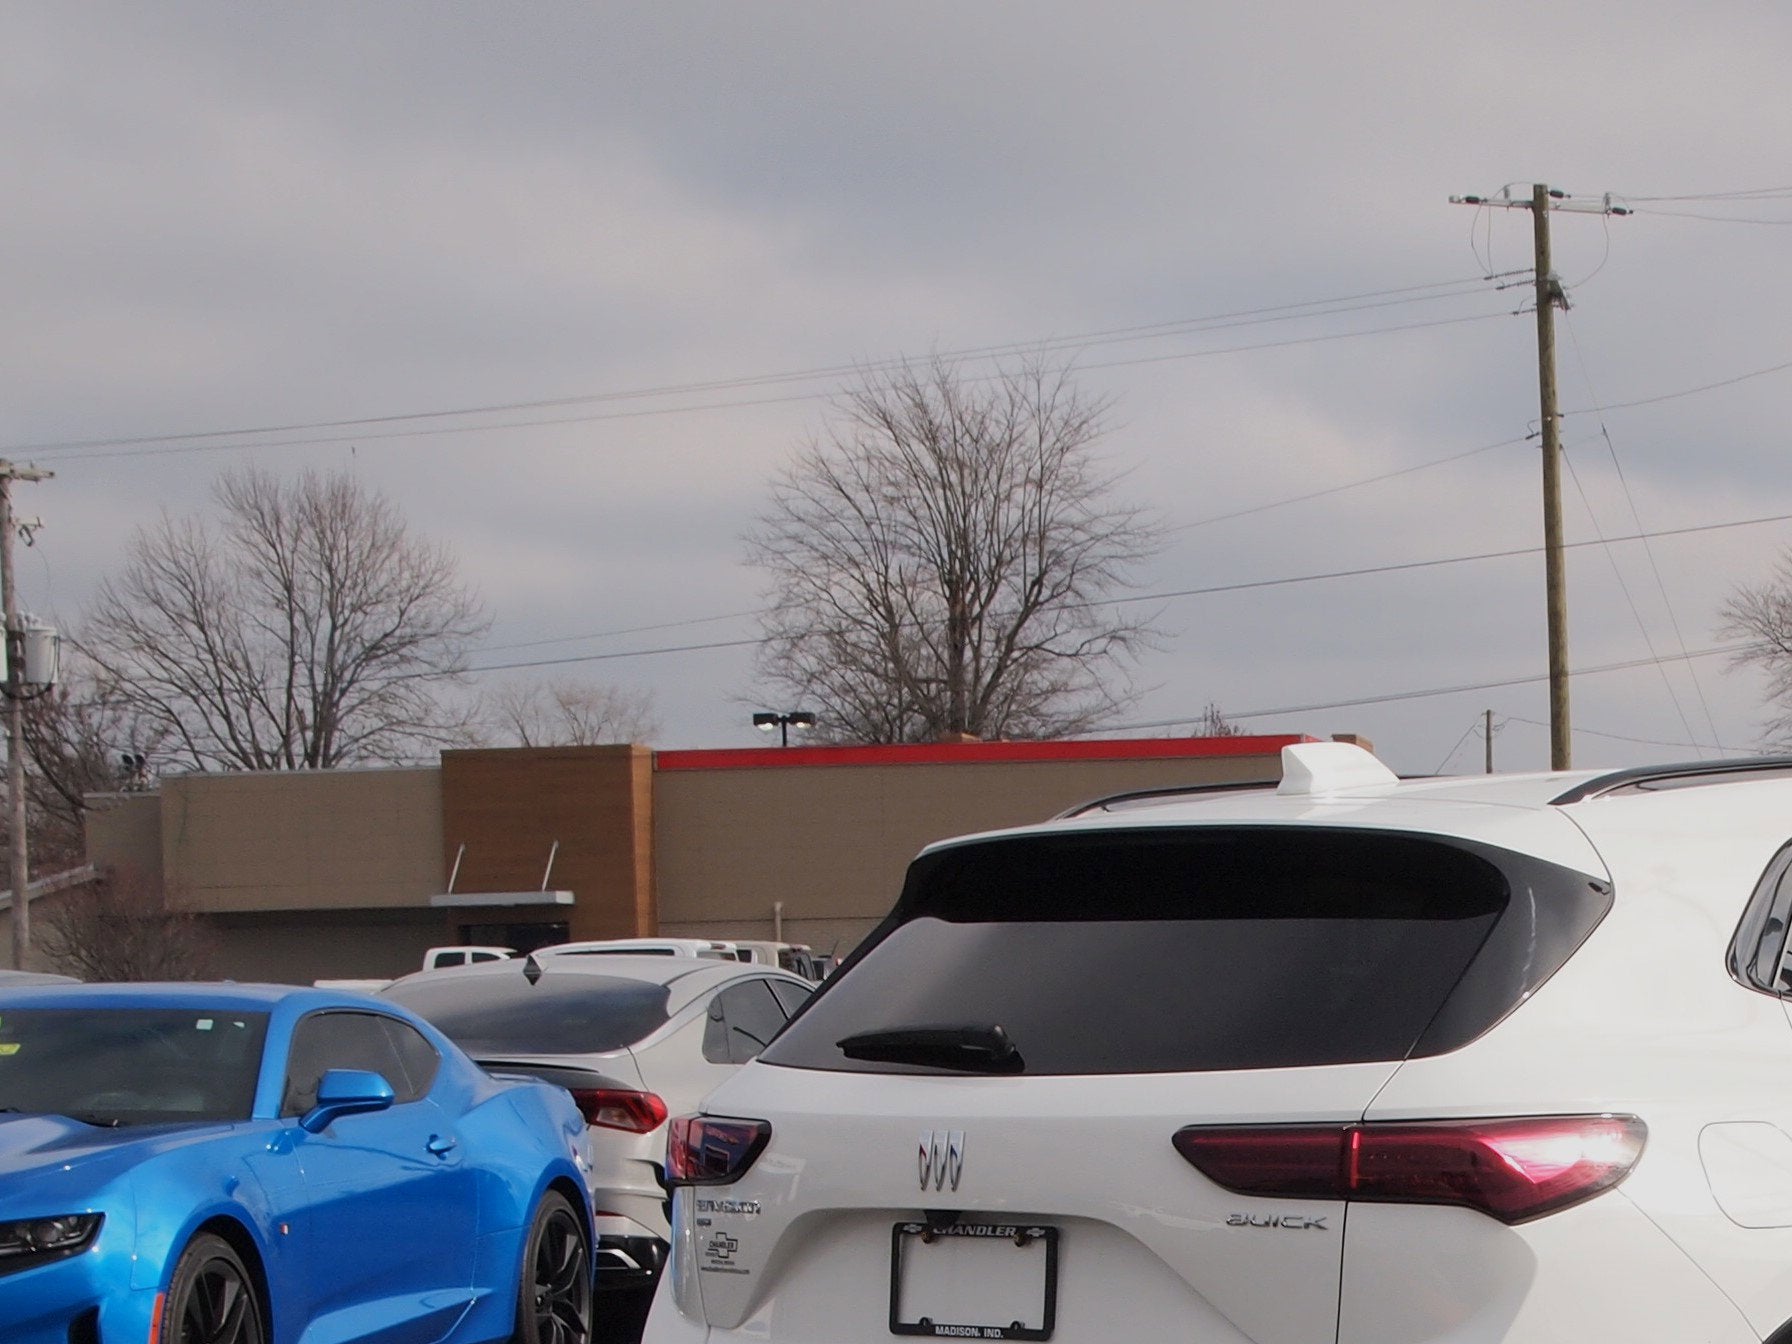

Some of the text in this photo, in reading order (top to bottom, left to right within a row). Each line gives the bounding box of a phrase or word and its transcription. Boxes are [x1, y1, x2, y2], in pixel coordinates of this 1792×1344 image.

[1225, 1213, 1328, 1231] BUICK
[932, 1224, 1017, 1237] CHANDLER
[983, 1328, 1004, 1339] IND.
